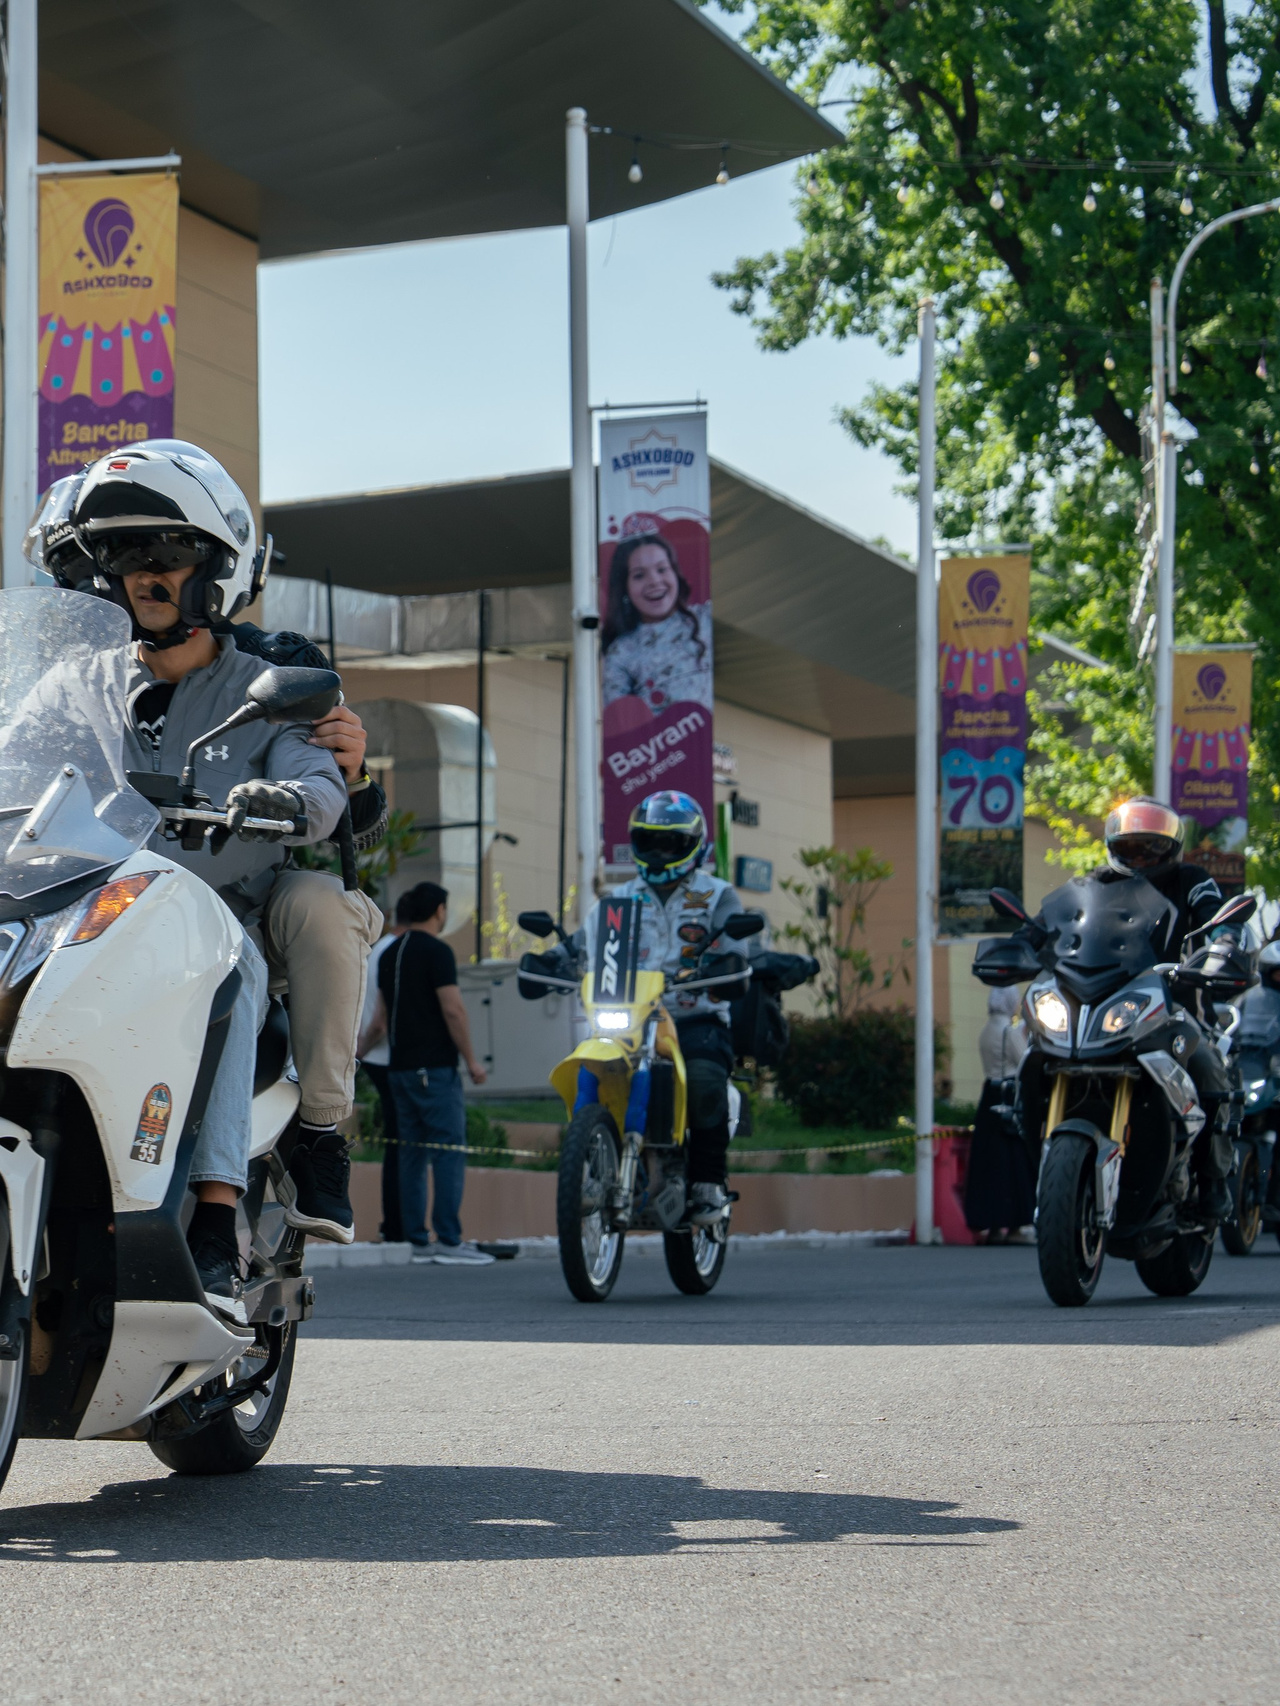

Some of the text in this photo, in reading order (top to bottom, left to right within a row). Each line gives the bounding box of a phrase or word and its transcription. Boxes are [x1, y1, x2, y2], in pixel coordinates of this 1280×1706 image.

[63, 274, 153, 295] ASHXOBOD
[62, 418, 149, 445] Barcha
[611, 448, 695, 473] ASHXOBOD
[46, 524, 74, 546] SHAR
[607, 711, 705, 778] Bayram
[621, 772, 648, 796] shu
[646, 750, 686, 783] yerda
[948, 774, 1015, 825] 70
[600, 904, 623, 997] DR-Z
[138, 1143, 158, 1164] 55
